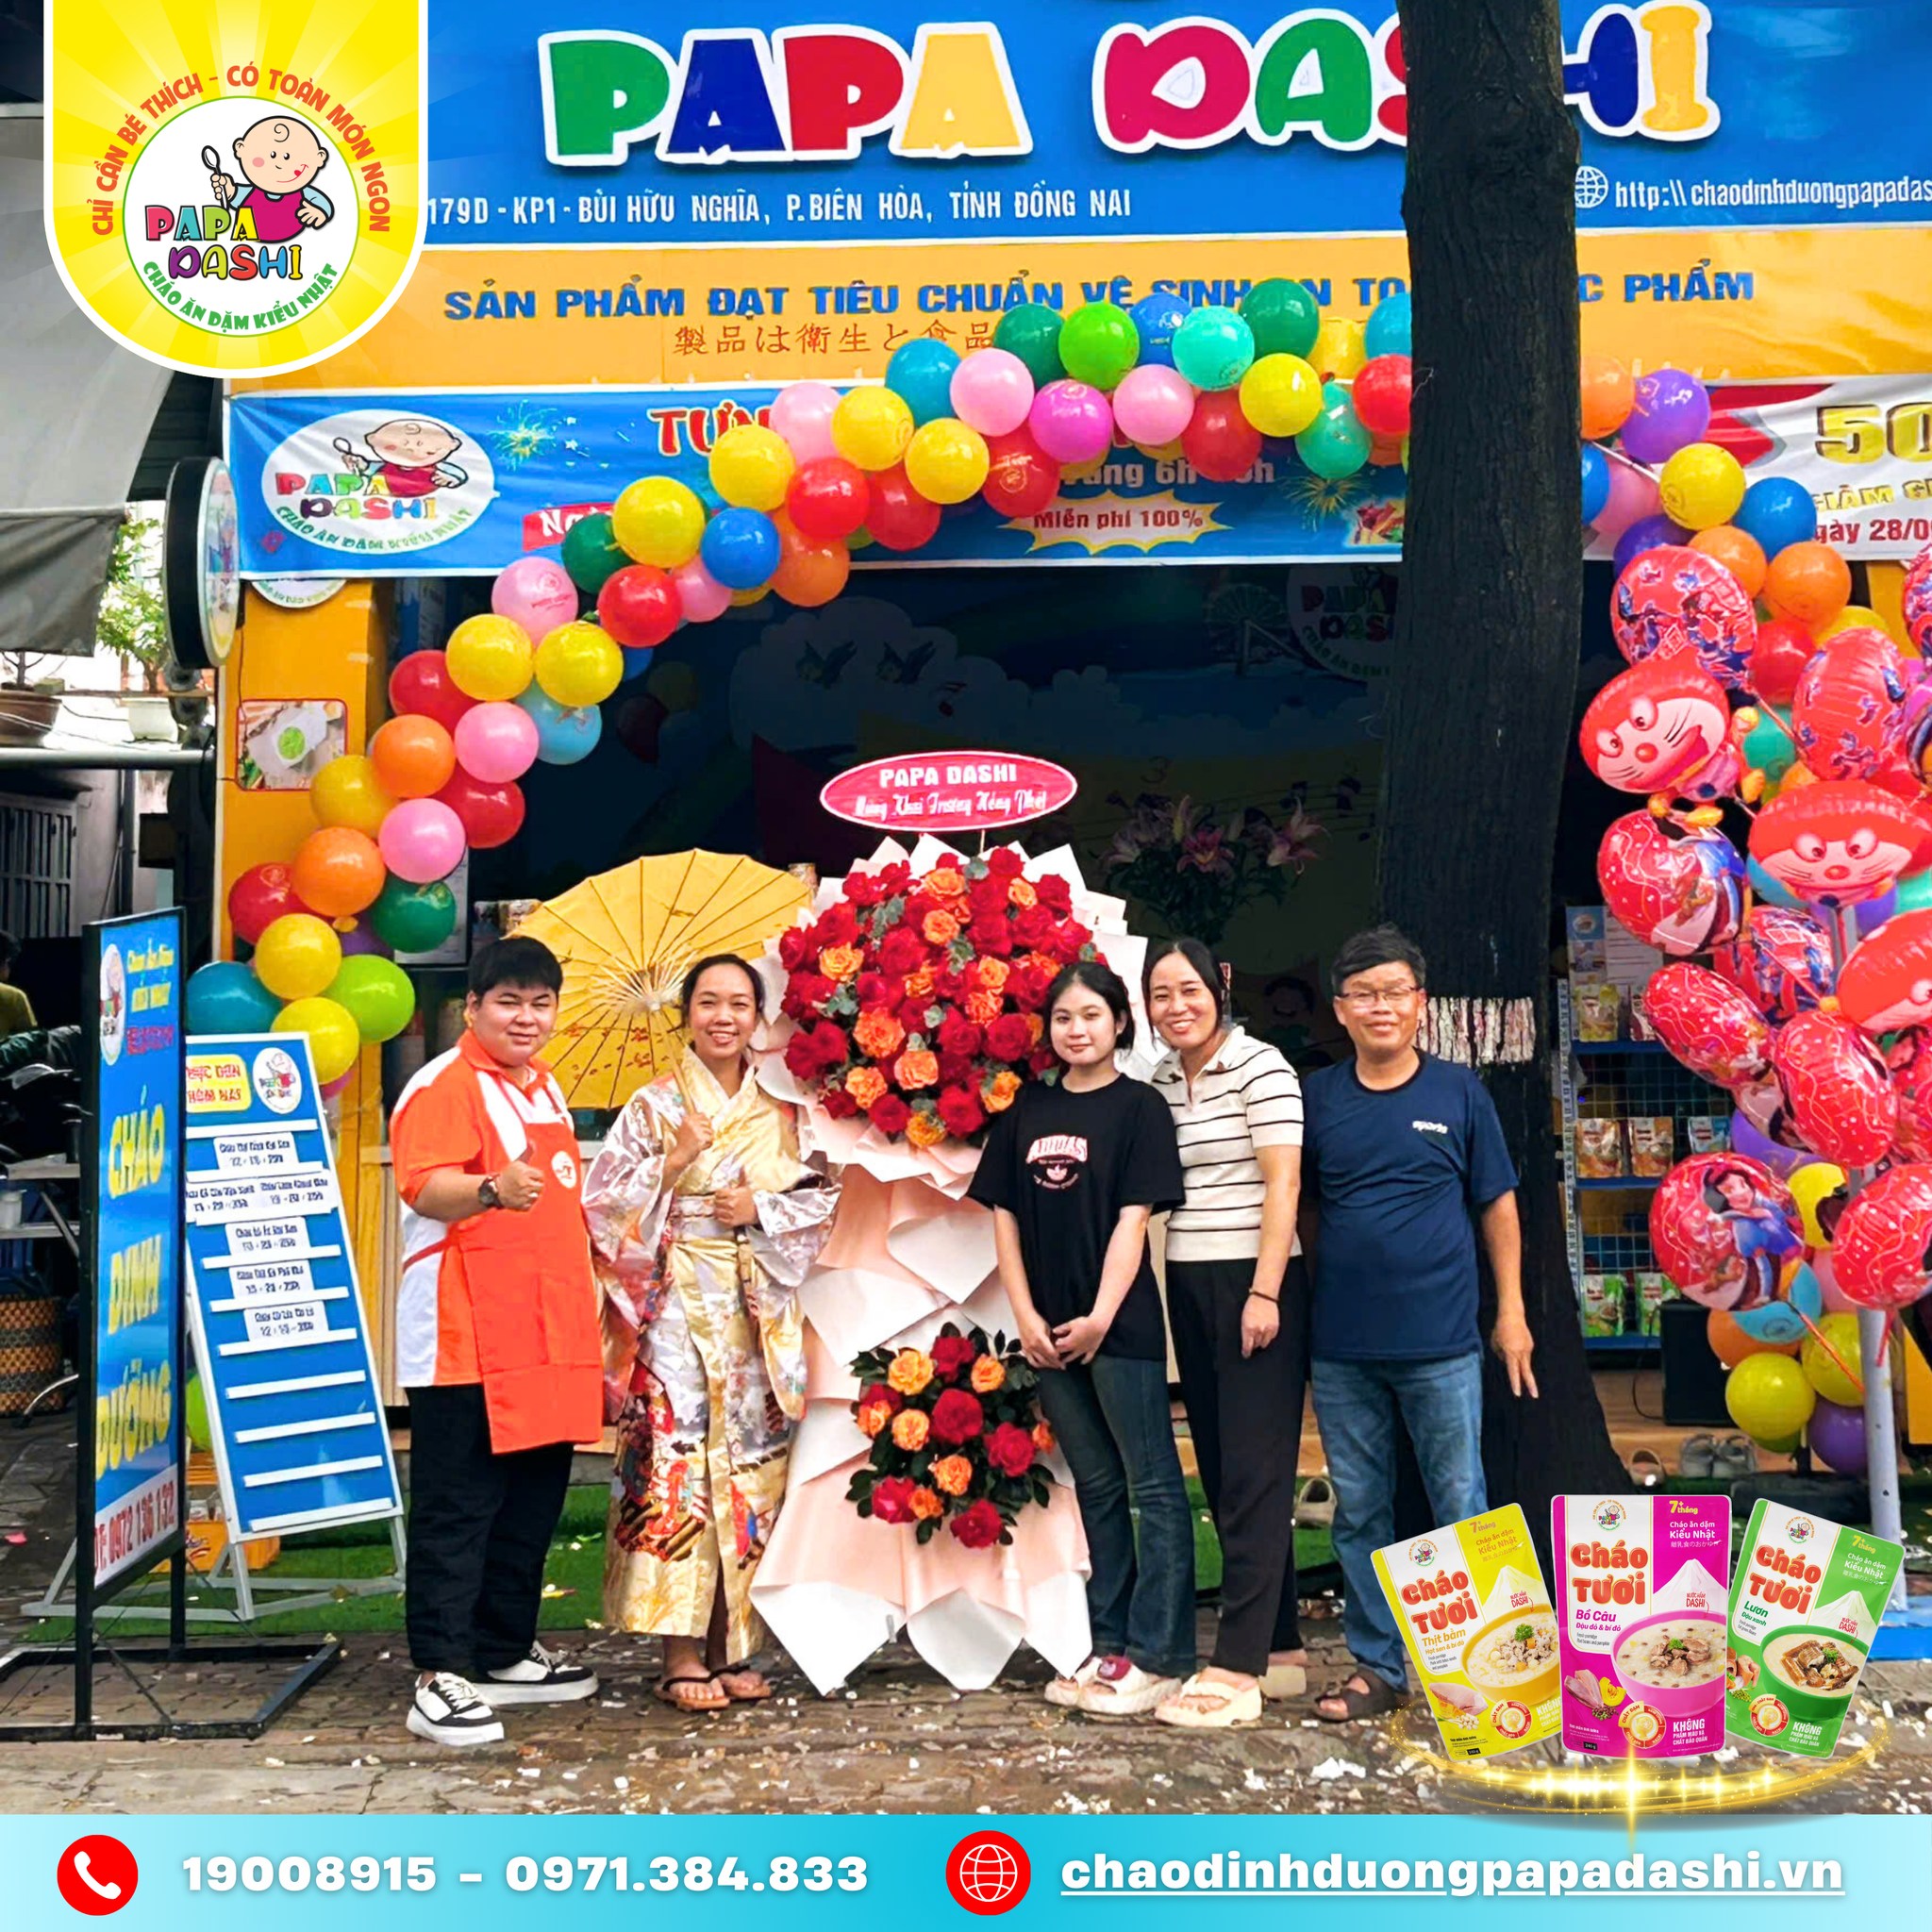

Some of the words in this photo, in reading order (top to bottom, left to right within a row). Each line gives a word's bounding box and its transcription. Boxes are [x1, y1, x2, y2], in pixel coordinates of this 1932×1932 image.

[538, 22, 1033, 166] PAPA
[1101, 0, 1721, 152] DAHI
[427, 197, 489, 225] 179D
[513, 196, 556, 225] KP1
[691, 188, 771, 225] NGHĨA,
[878, 184, 933, 224] HÒA,
[1090, 189, 1132, 218] NAI
[443, 279, 536, 320] SẢN
[556, 274, 686, 318] PHẨM
[708, 286, 790, 321] ĐẠT
[809, 280, 900, 314] TIÊU
[918, 270, 1063, 314] CHUẨN
[1624, 258, 1754, 303] PHẨM
[275, 472, 389, 496] PAPA
[300, 496, 439, 520] DASHI
[1097, 508, 1132, 530] phí
[1140, 508, 1204, 528] 100%
[879, 766, 940, 789] PAPA
[946, 763, 1018, 785] DASHI
